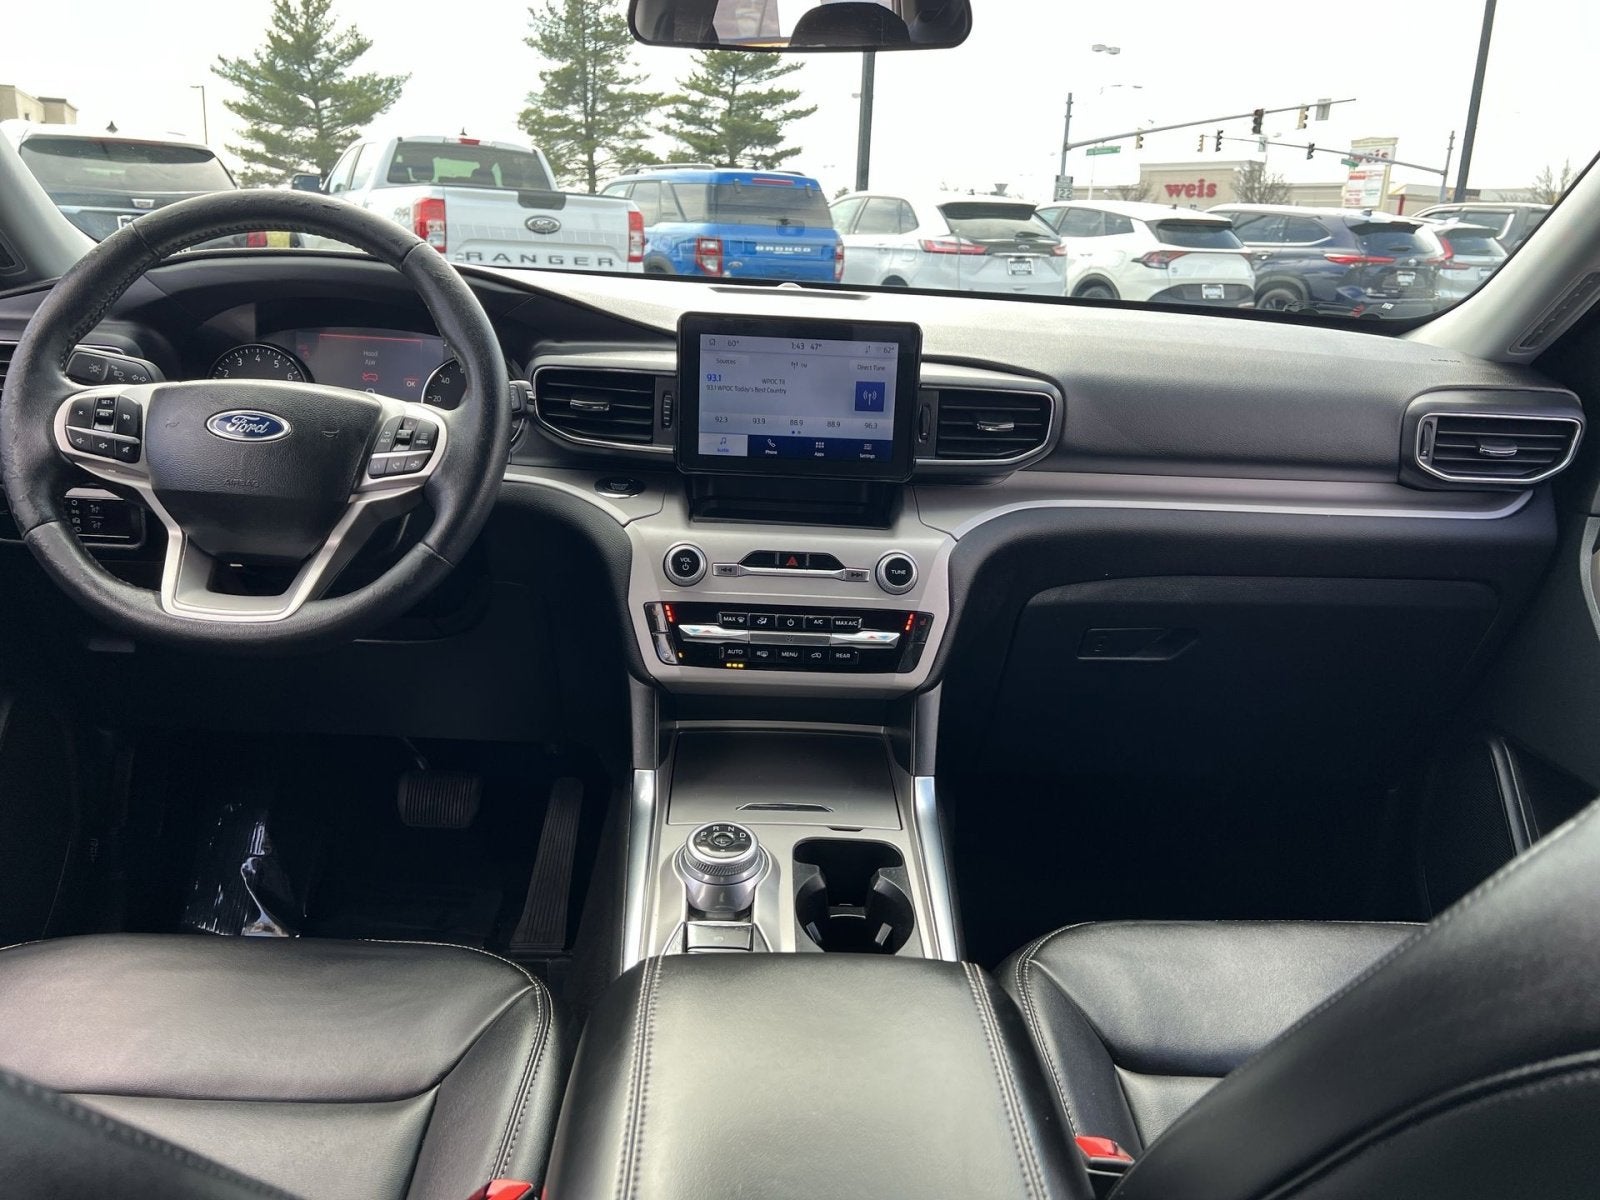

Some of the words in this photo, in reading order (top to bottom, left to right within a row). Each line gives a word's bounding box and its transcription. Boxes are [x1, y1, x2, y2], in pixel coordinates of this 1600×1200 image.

[1164, 178, 1217, 198] weis
[465, 251, 614, 267] RANGER
[791, 342, 805, 350] 1:43
[237, 358, 243, 366] 3
[255, 354, 261, 362] 4
[273, 360, 280, 369] 5
[223, 370, 229, 378] 2
[706, 373, 722, 382] 93.1
[225, 415, 270, 434] Ford
